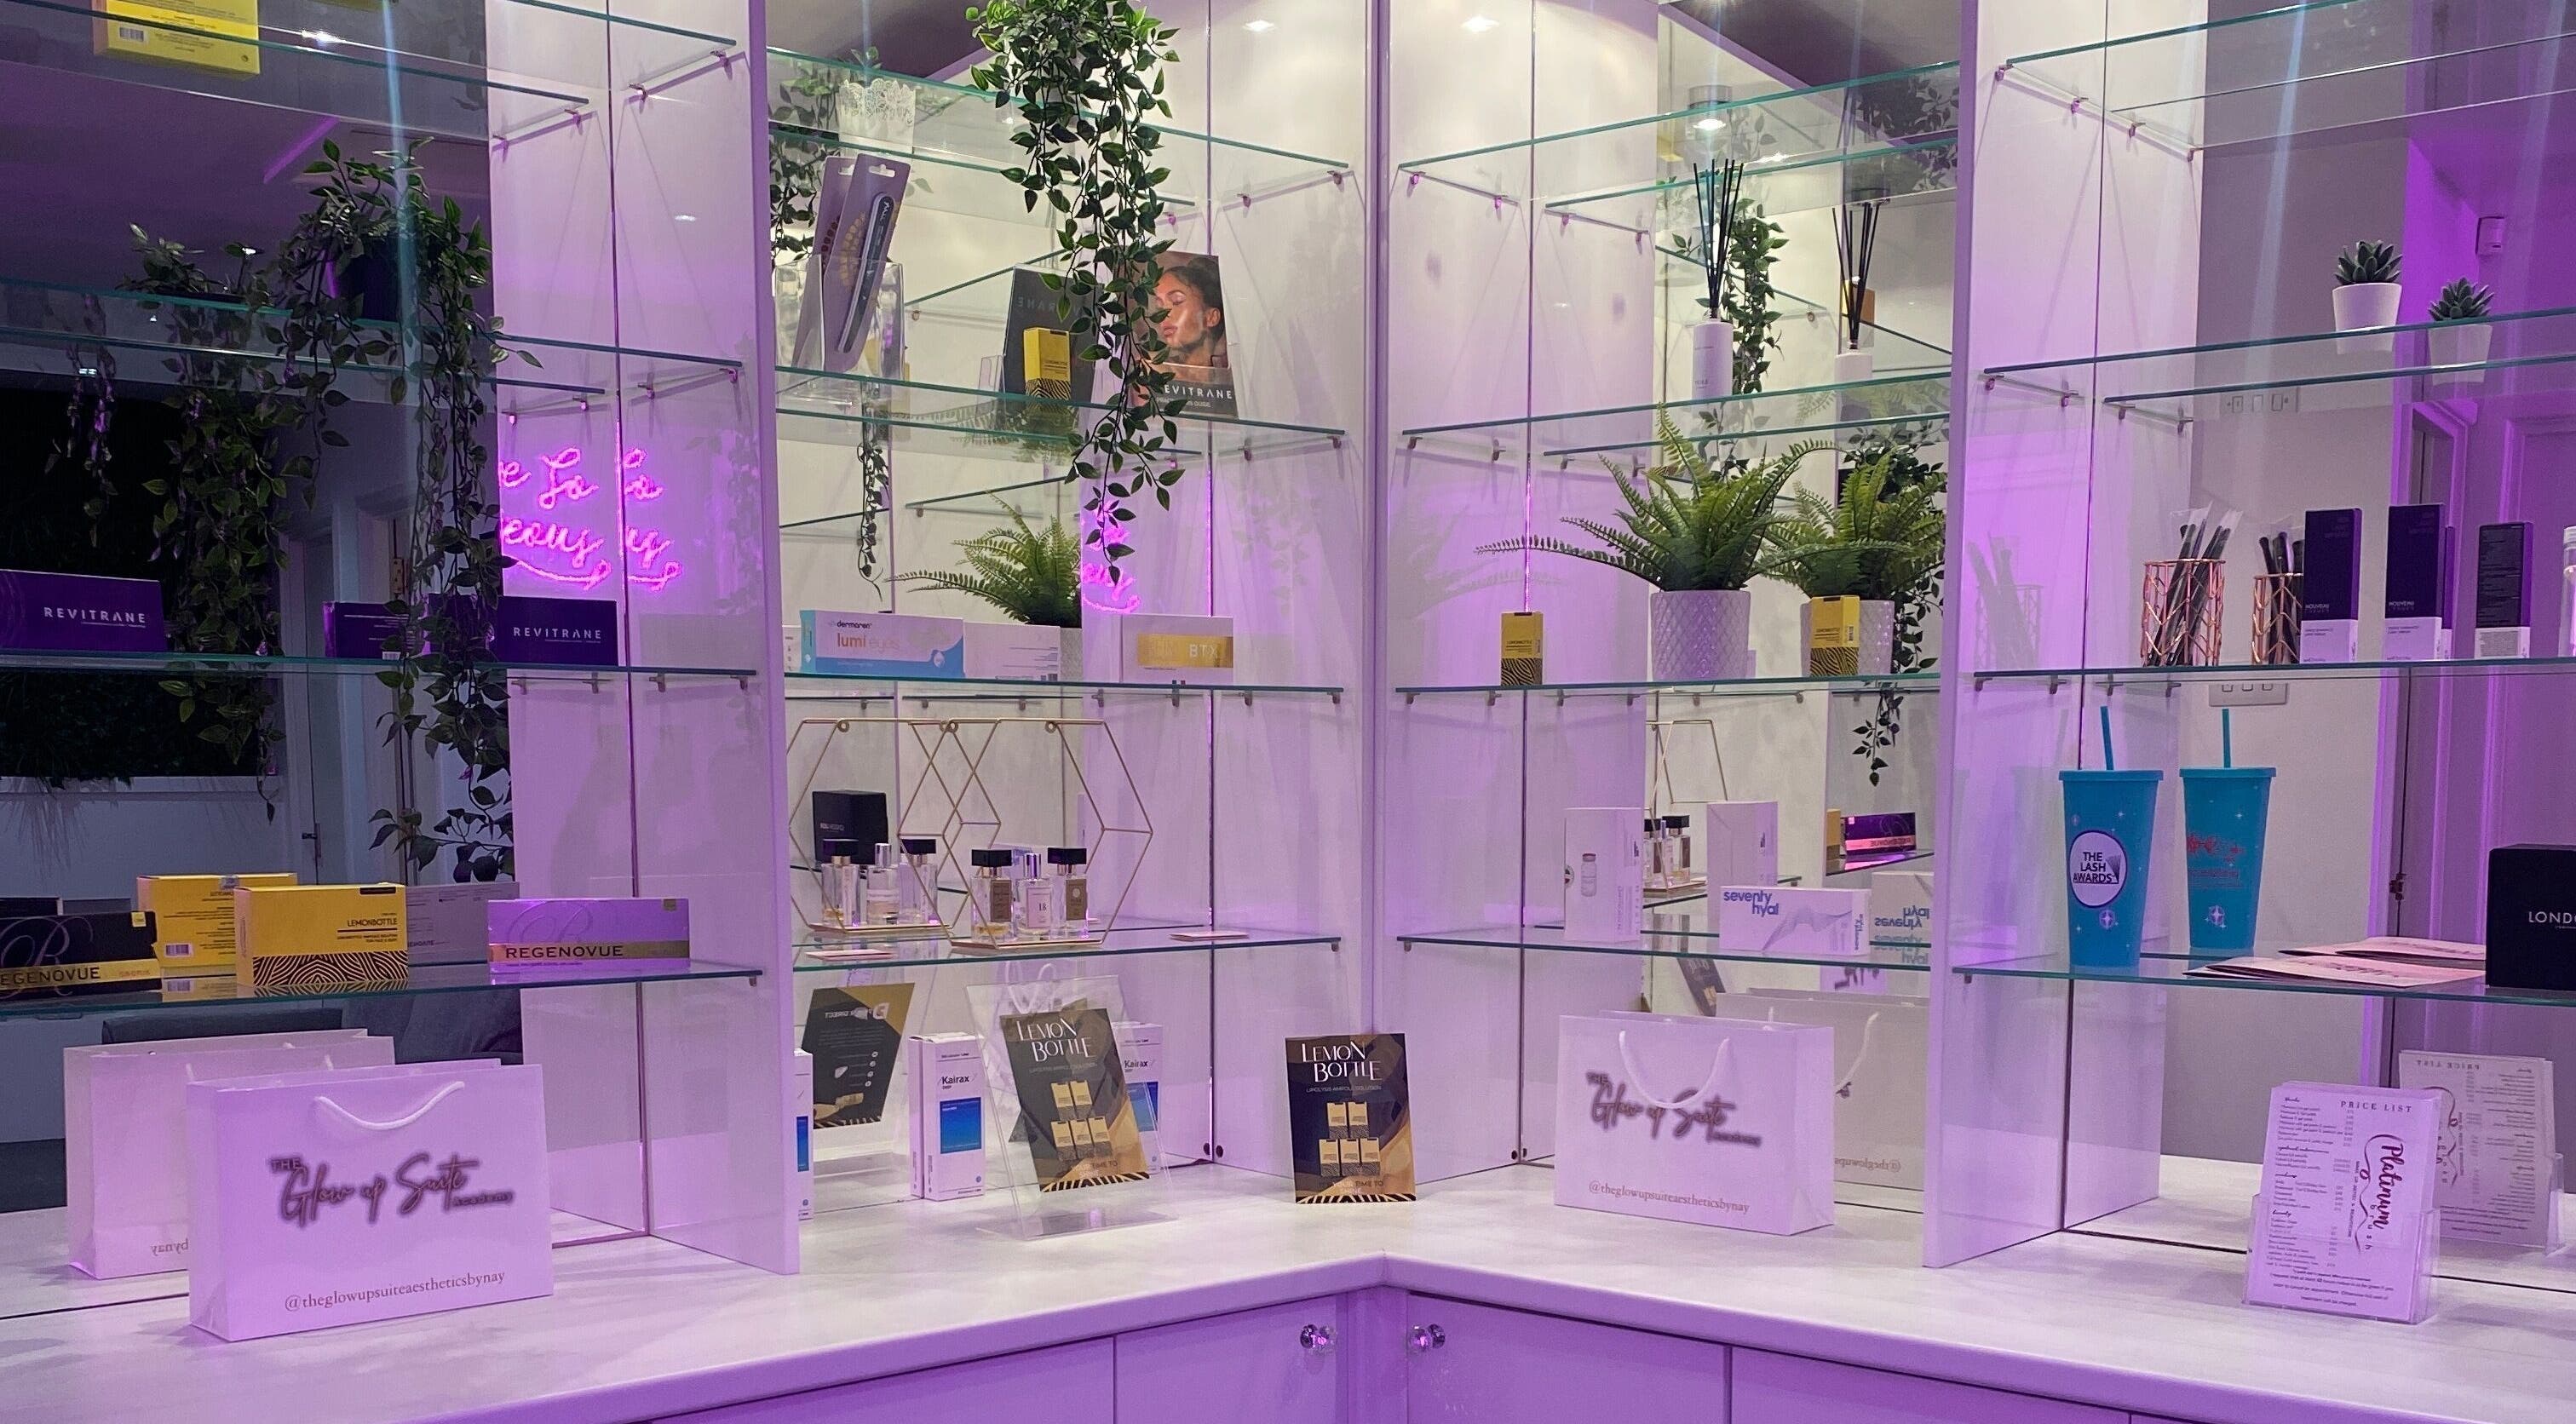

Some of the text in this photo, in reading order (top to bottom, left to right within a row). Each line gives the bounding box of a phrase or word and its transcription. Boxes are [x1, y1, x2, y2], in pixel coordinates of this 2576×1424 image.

[1164, 384, 1233, 399] EVITRANE
[43, 606, 146, 623] REVITRANE
[513, 626, 601, 640] REVITRANE
[837, 632, 866, 648] lumi
[2083, 851, 2104, 862] THE
[2079, 862, 2107, 873] LASH
[2073, 872, 2113, 884] AWARDS
[1722, 890, 1773, 904] seventy
[1751, 902, 1780, 917] hyal
[505, 945, 624, 959] REGENOVUE
[1016, 1018, 1078, 1042] LEMON
[1031, 1036, 1096, 1062] BOTTLE
[1301, 1041, 1366, 1063] LEMON
[1124, 1059, 1148, 1069] Kairax
[1314, 1060, 1383, 1082] BOTTLE
[940, 1074, 969, 1085] Kairax
[2383, 1104, 2412, 1113] LIST
[270, 1157, 302, 1173] THE
[282, 1151, 480, 1227] Glow up Suite
[2372, 1143, 2405, 1230] Platinum
[1589, 1180, 1750, 1215] @theglowupsuiteaestheticsbynay
[285, 1272, 506, 1312] @theglowupsuiteaestheticsbynay
